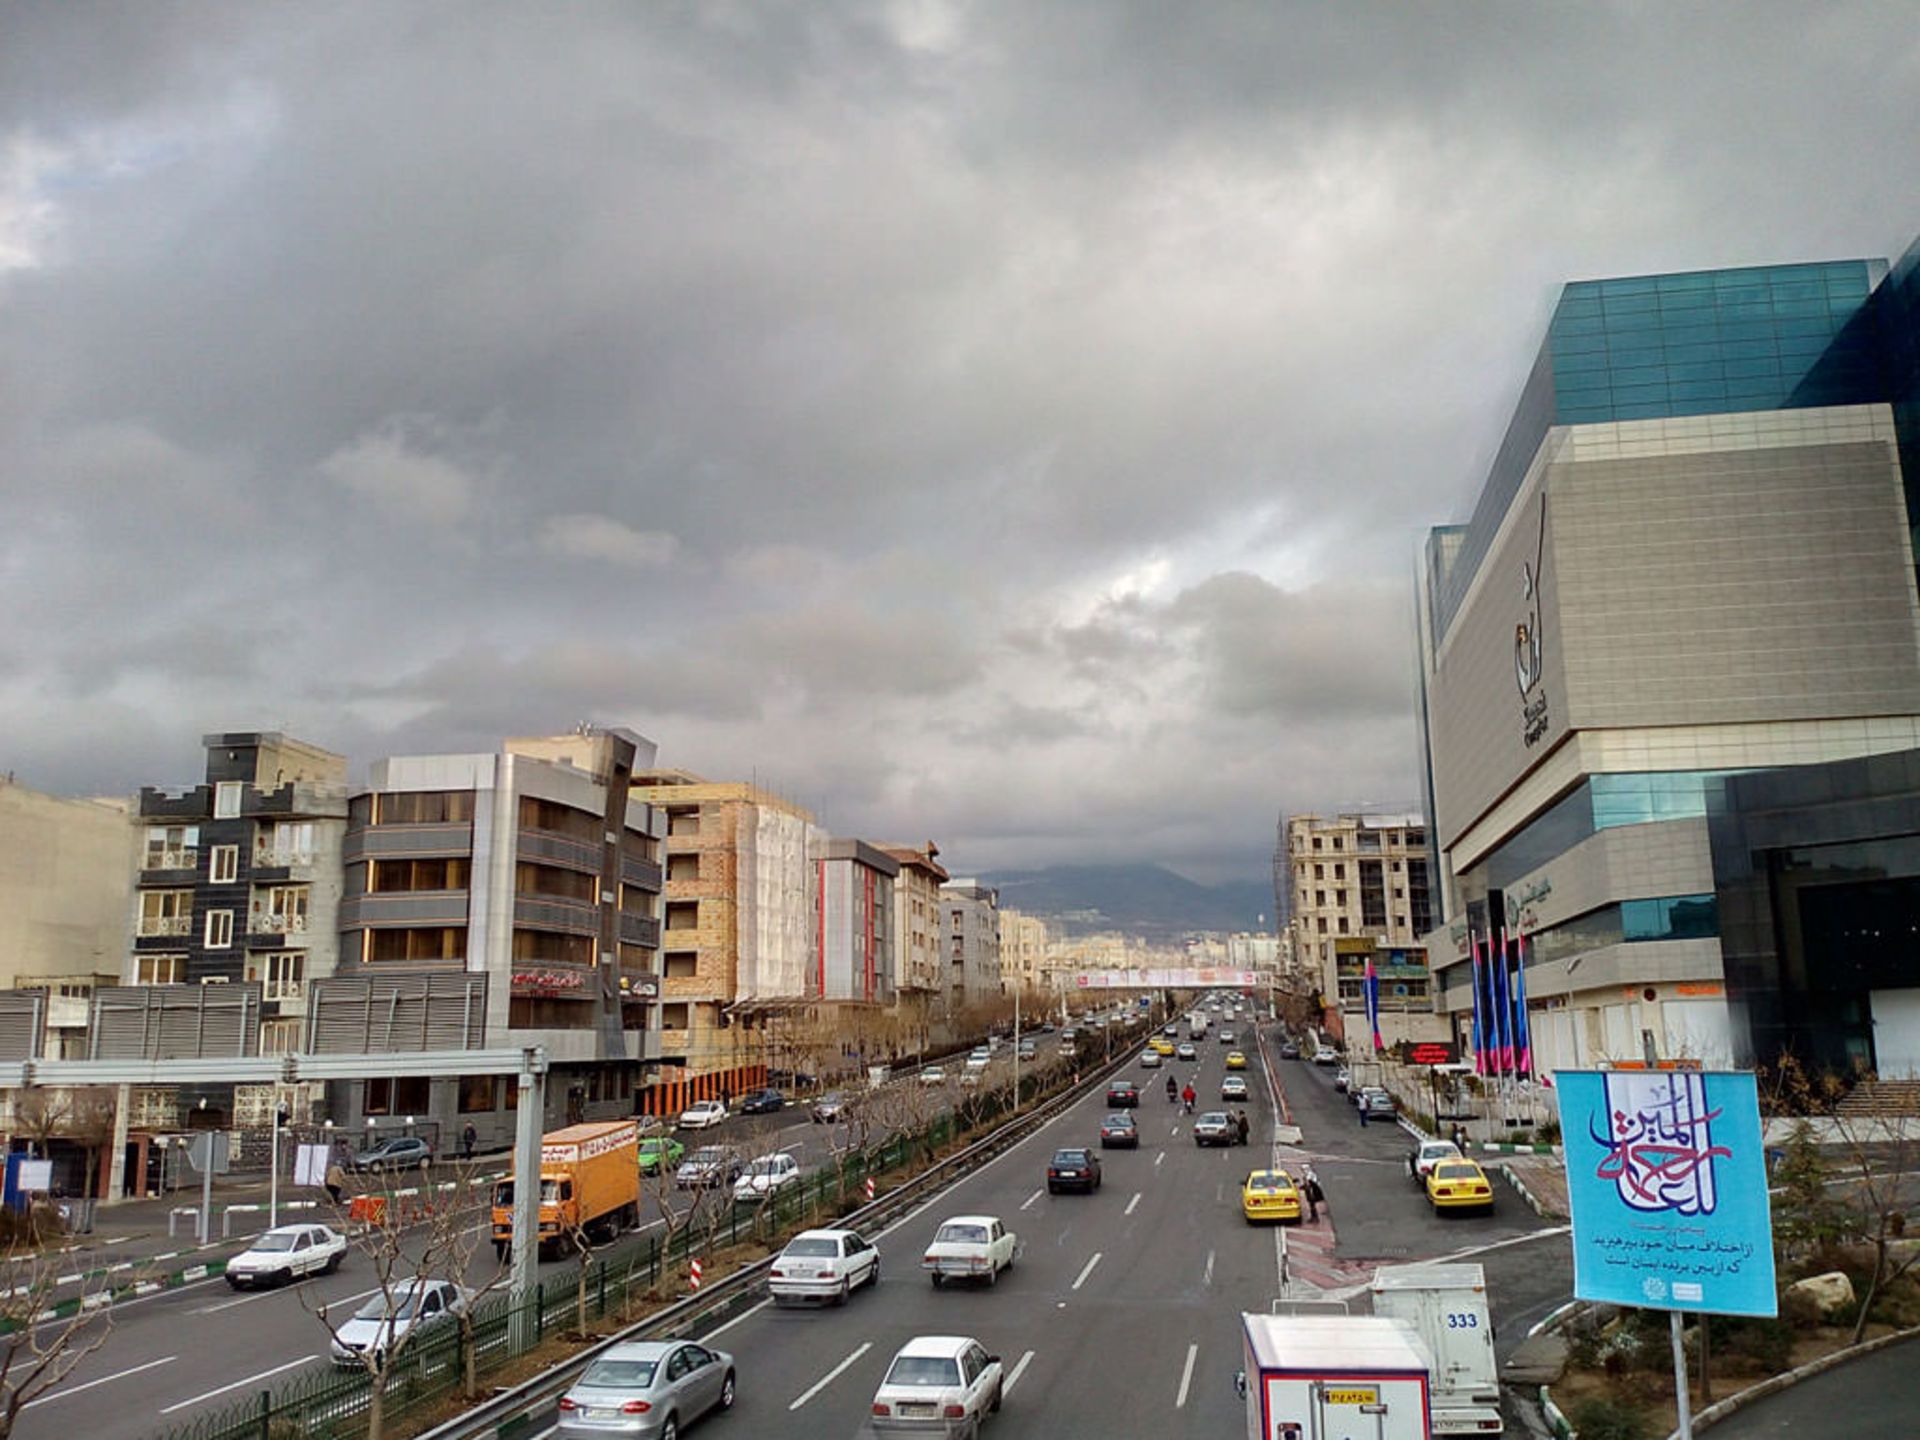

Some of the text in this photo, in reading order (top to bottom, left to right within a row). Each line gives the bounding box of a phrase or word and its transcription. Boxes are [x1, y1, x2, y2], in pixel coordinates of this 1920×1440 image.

[1639, 1240, 1662, 1252] خود
[1666, 1232, 1694, 1251] میان
[1697, 1238, 1744, 1254] اختلاف
[1604, 1253, 1630, 1265] است
[1727, 1260, 1741, 1274] که
[1448, 1313, 1477, 1328] 333
